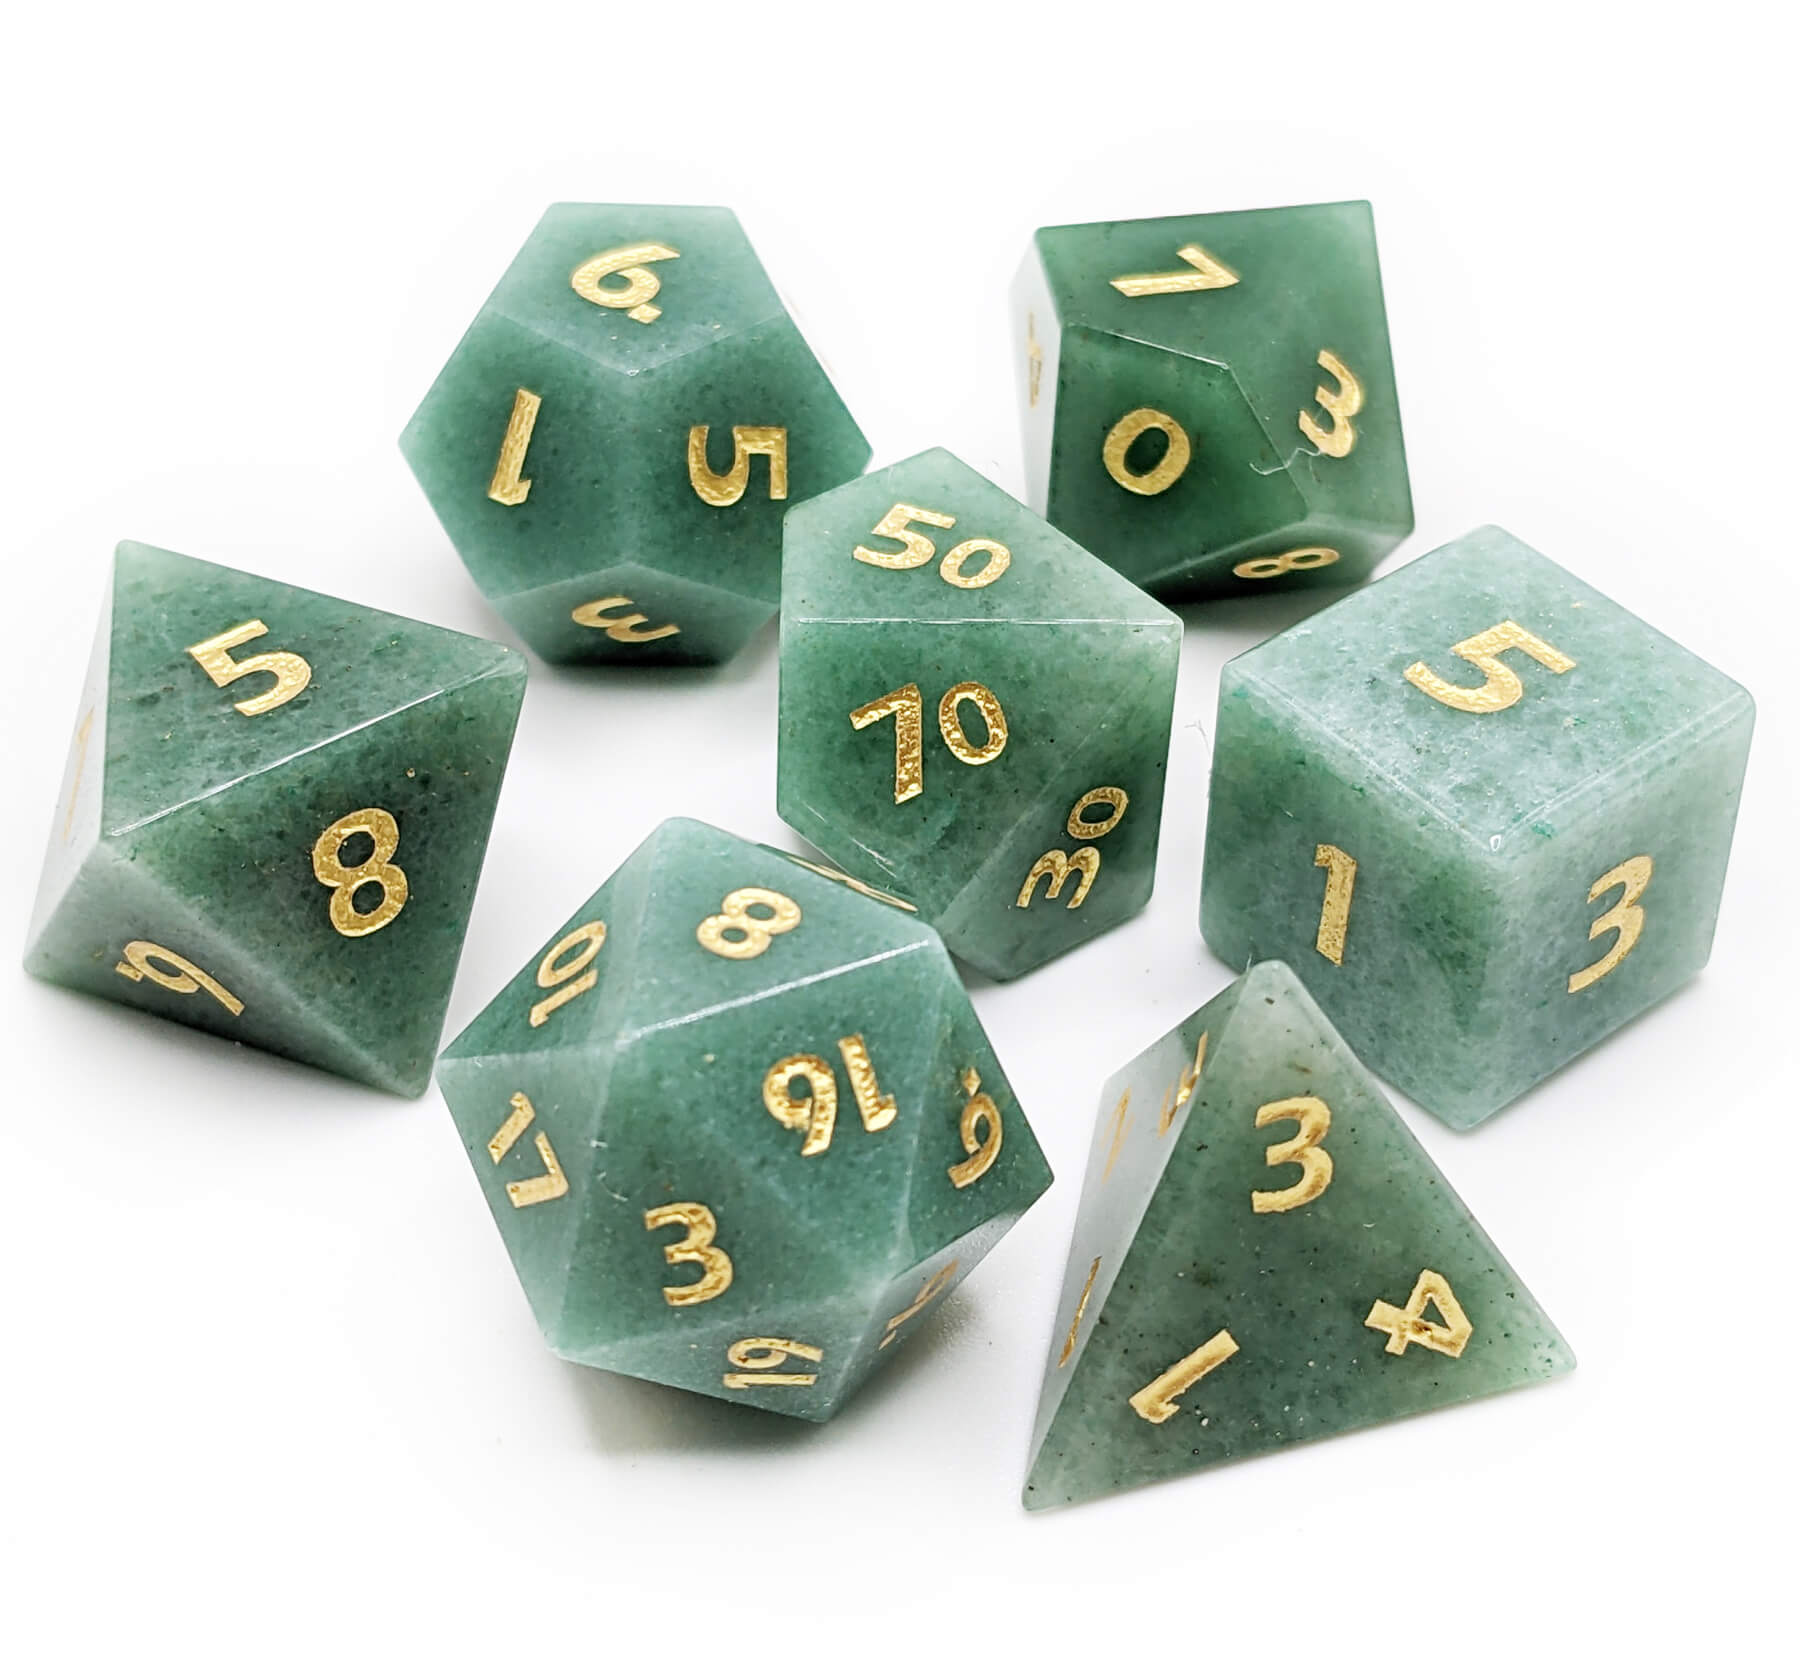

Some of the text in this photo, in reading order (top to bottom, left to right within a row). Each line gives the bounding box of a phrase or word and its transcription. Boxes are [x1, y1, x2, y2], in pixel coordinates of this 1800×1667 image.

[487, 388, 542, 507] 1
[1102, 407, 1192, 496] 0
[1298, 349, 1364, 459] 3
[687, 425, 788, 507] 5
[852, 503, 1012, 590] 50
[1233, 546, 1341, 580] 8
[188, 619, 313, 717] 5
[570, 594, 681, 643] 3
[1403, 620, 1577, 714] 5
[849, 682, 1009, 805] 70
[310, 807, 410, 938] 8
[1016, 786, 1129, 910] 30
[695, 886, 803, 961] 8
[1313, 843, 1359, 967] 1
[1567, 854, 1654, 994] 3
[529, 920, 607, 1028] 10
[762, 1033, 899, 1158] 16
[487, 1090, 570, 1209] 17
[1251, 1095, 1335, 1214] 3
[644, 1201, 735, 1308] 3
[722, 1335, 824, 1390] 19
[1363, 1268, 1474, 1360] 4
[1127, 1328, 1241, 1425] 1
